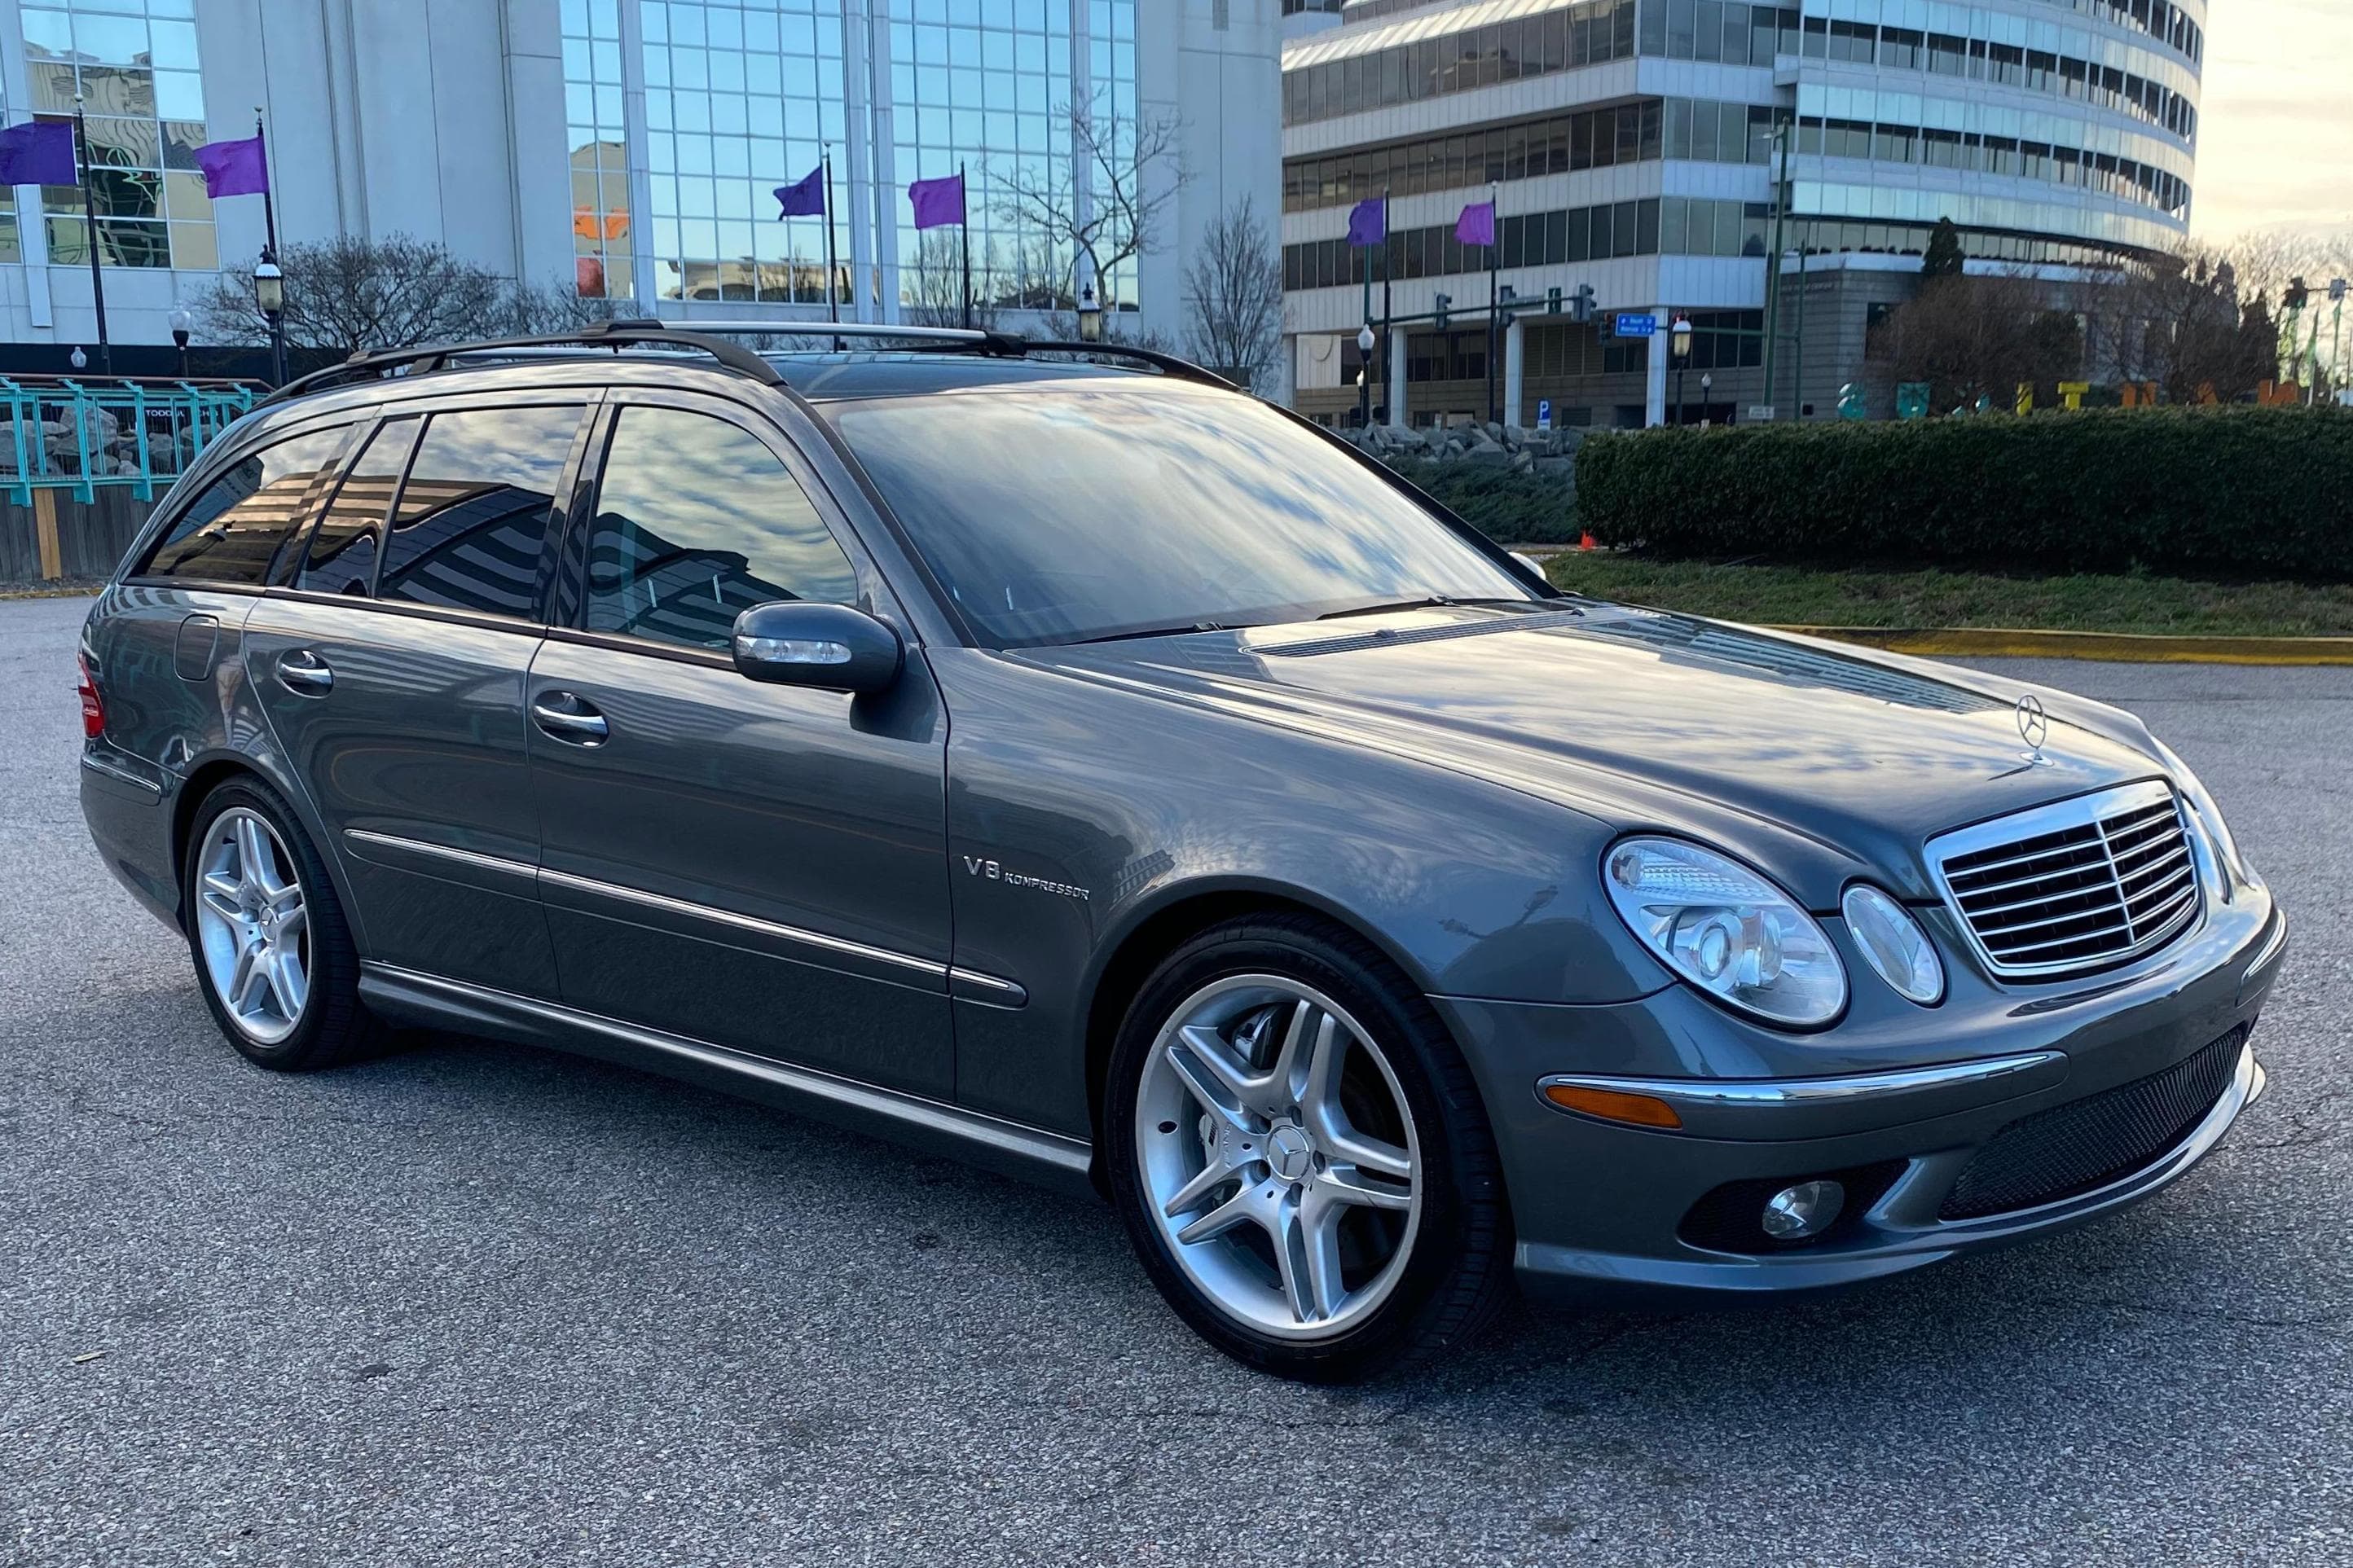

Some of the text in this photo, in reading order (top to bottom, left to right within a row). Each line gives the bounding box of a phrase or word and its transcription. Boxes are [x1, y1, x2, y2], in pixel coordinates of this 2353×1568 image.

[1540, 401, 1549, 419] P
[963, 855, 1090, 901] V8 KOMPRESSOR
